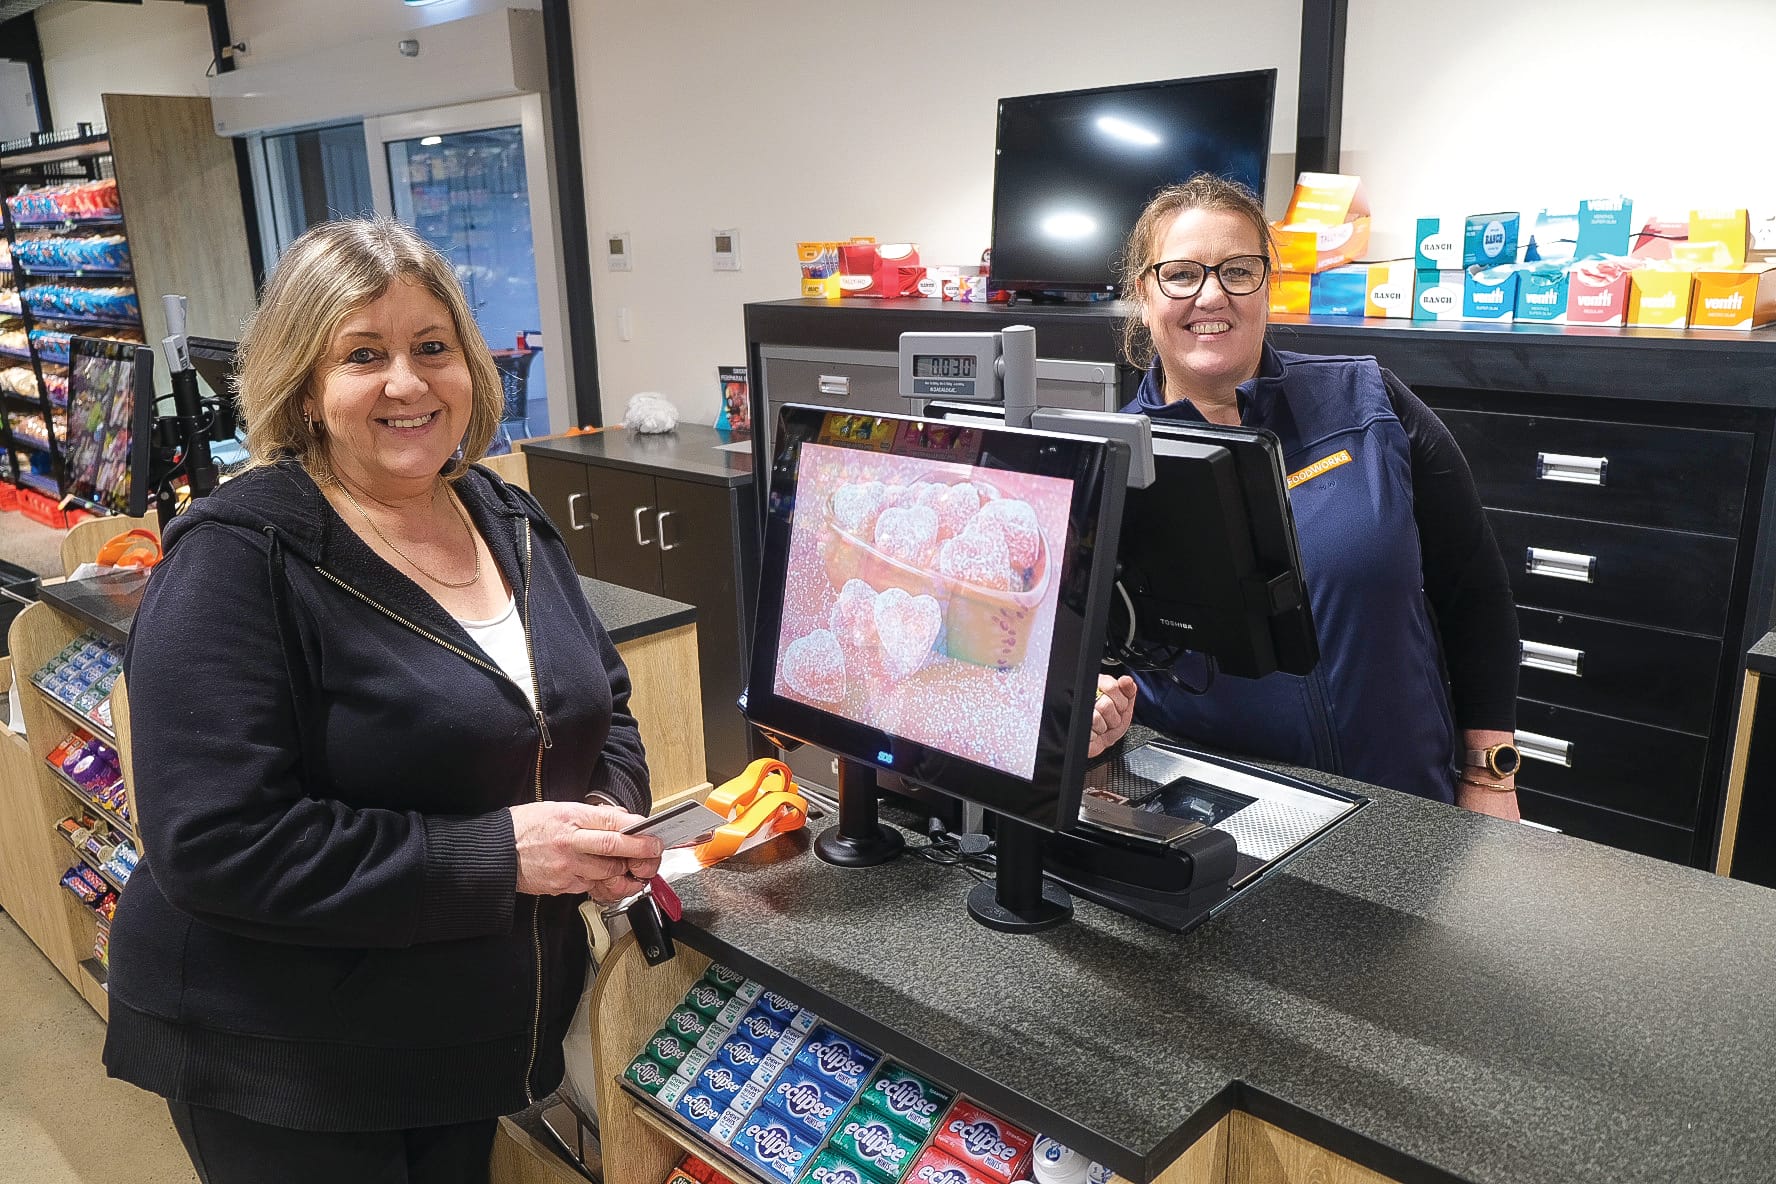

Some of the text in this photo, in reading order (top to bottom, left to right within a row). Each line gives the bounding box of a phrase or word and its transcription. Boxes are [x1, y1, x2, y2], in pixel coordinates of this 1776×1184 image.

[1424, 243, 1452, 251] RANCH
[1374, 292, 1401, 300] RANCH
[1423, 296, 1452, 304] RANCH
[1286, 453, 1348, 485] FOODWORKS
[1159, 618, 1193, 630] TOSHIBA
[711, 962, 744, 982] eclipse
[691, 987, 725, 1008] eclipse
[764, 990, 799, 1013] eclipse
[671, 1012, 705, 1034] eclipse
[744, 1017, 778, 1039] eclipse
[652, 1037, 686, 1060] eclipse
[724, 1042, 759, 1066] eclipse
[808, 1041, 865, 1076] eclipse
[632, 1062, 665, 1086] eclipse
[704, 1068, 739, 1093] eclipse
[837, 1074, 851, 1086] MINTS
[684, 1095, 718, 1120] eclipse
[777, 1082, 833, 1119] eclipse
[875, 1079, 938, 1116] eclipse
[805, 1115, 820, 1129] MINTS
[908, 1112, 923, 1124] MINTS
[746, 1124, 802, 1164] eclipse
[844, 1122, 906, 1162] eclipse
[949, 1119, 1017, 1162] eclipse
[1005, 1129, 1028, 1144] Strawberry
[773, 1160, 788, 1172] MINTS
[876, 1157, 891, 1170] MINTS
[985, 1156, 1002, 1170] MINTS
